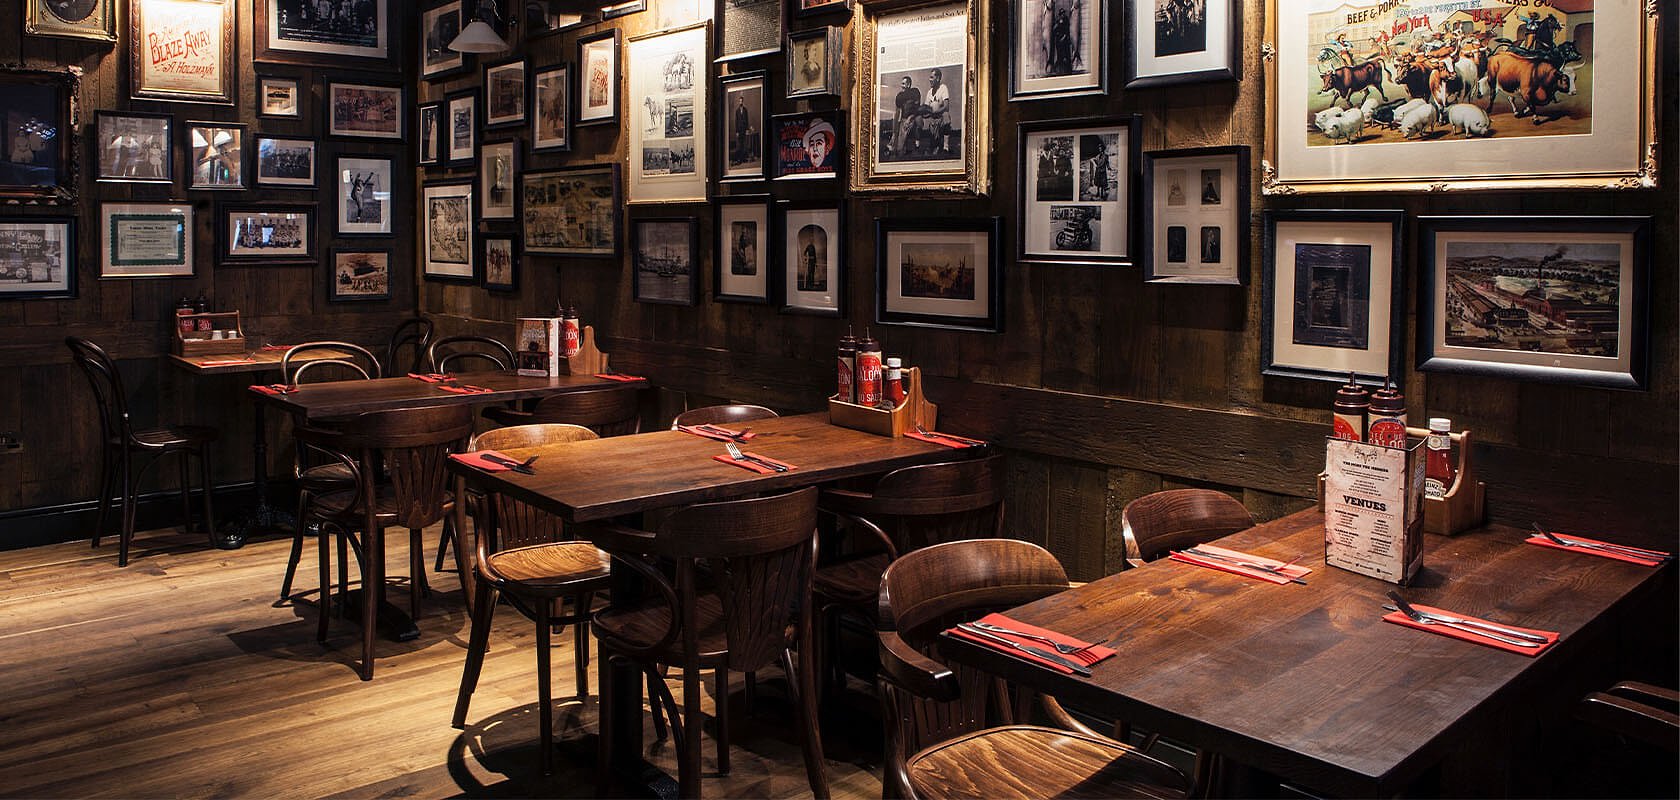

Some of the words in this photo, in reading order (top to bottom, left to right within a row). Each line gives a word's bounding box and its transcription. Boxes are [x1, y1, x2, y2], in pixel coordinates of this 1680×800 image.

[1347, 10, 1368, 25] BEEF
[1369, 8, 1379, 19] &
[1391, 20, 1408, 38] New
[1407, 14, 1432, 33] York
[149, 32, 184, 65] BLAZE
[183, 30, 211, 59] AWAY
[1343, 495, 1387, 511] VENUES
